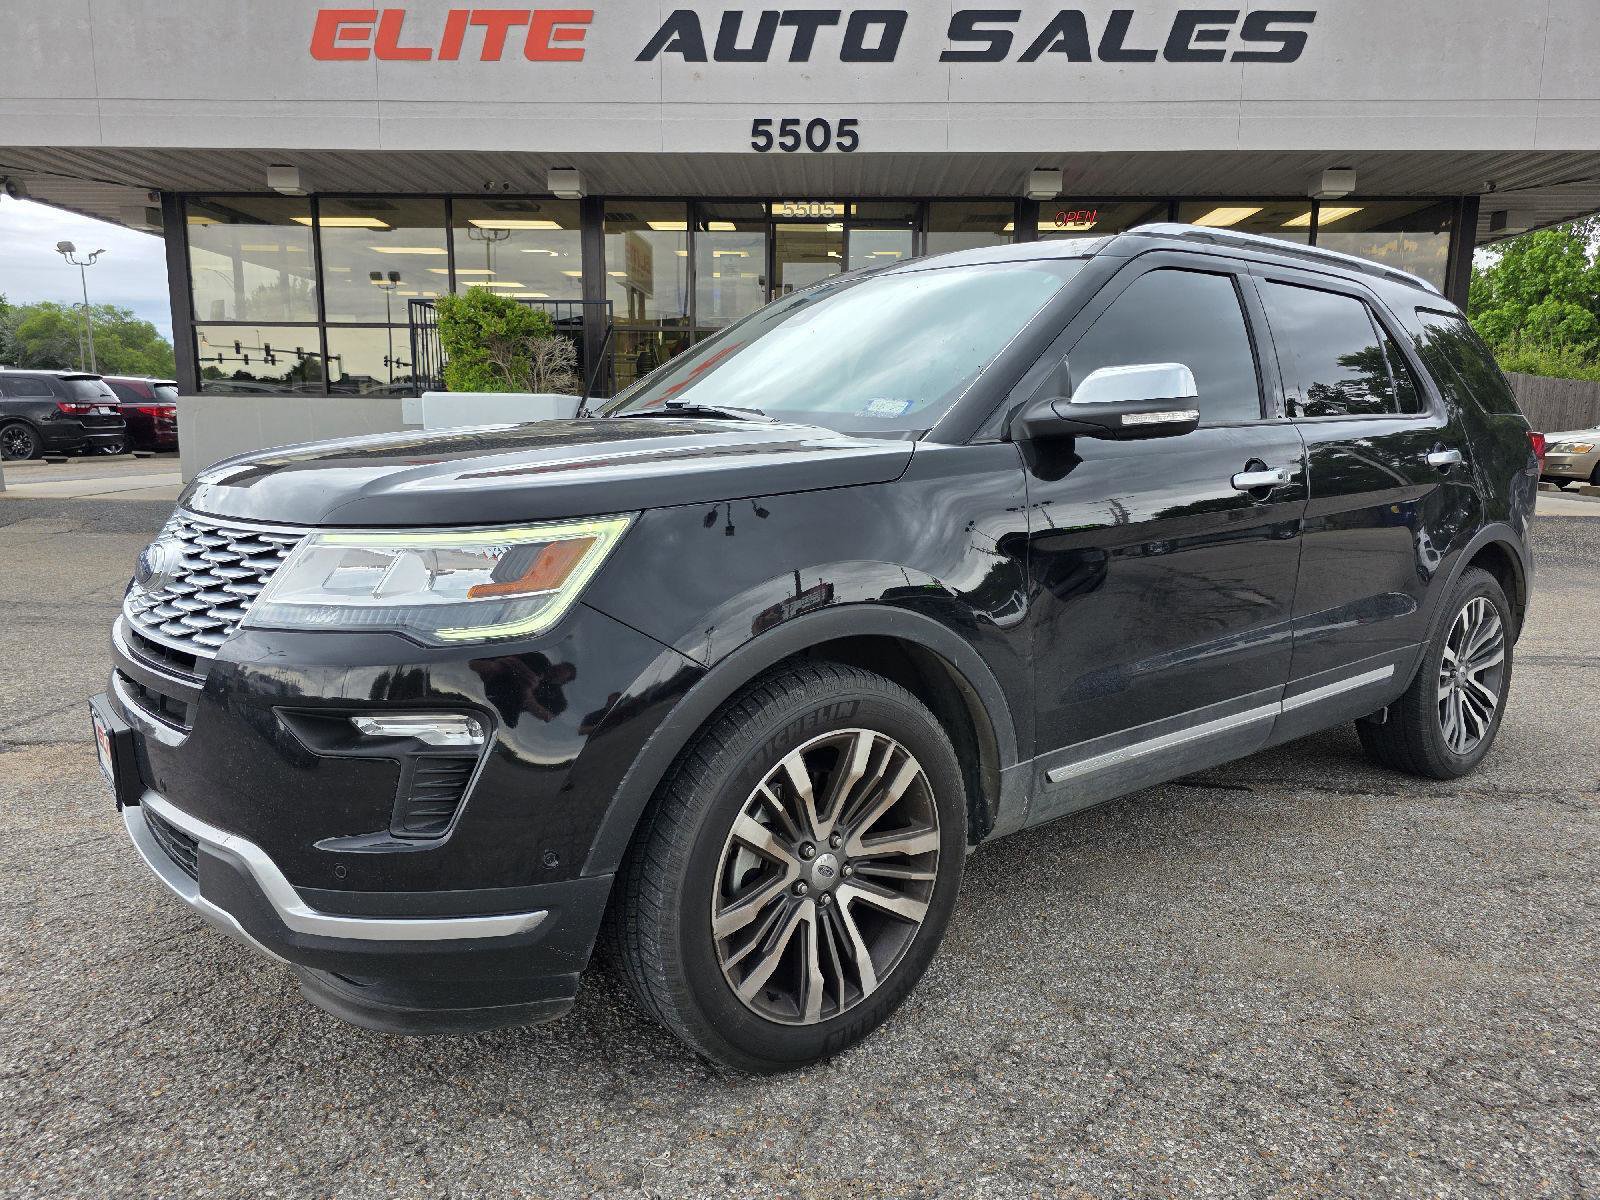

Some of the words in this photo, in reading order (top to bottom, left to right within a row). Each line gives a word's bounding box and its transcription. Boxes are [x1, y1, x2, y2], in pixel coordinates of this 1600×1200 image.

[310, 9, 594, 61] ELITE
[634, 9, 908, 62] AUTO
[938, 9, 1317, 62] SALES
[751, 117, 859, 152] 5505
[782, 201, 835, 218] 5505
[1055, 209, 1097, 227] OPEN
